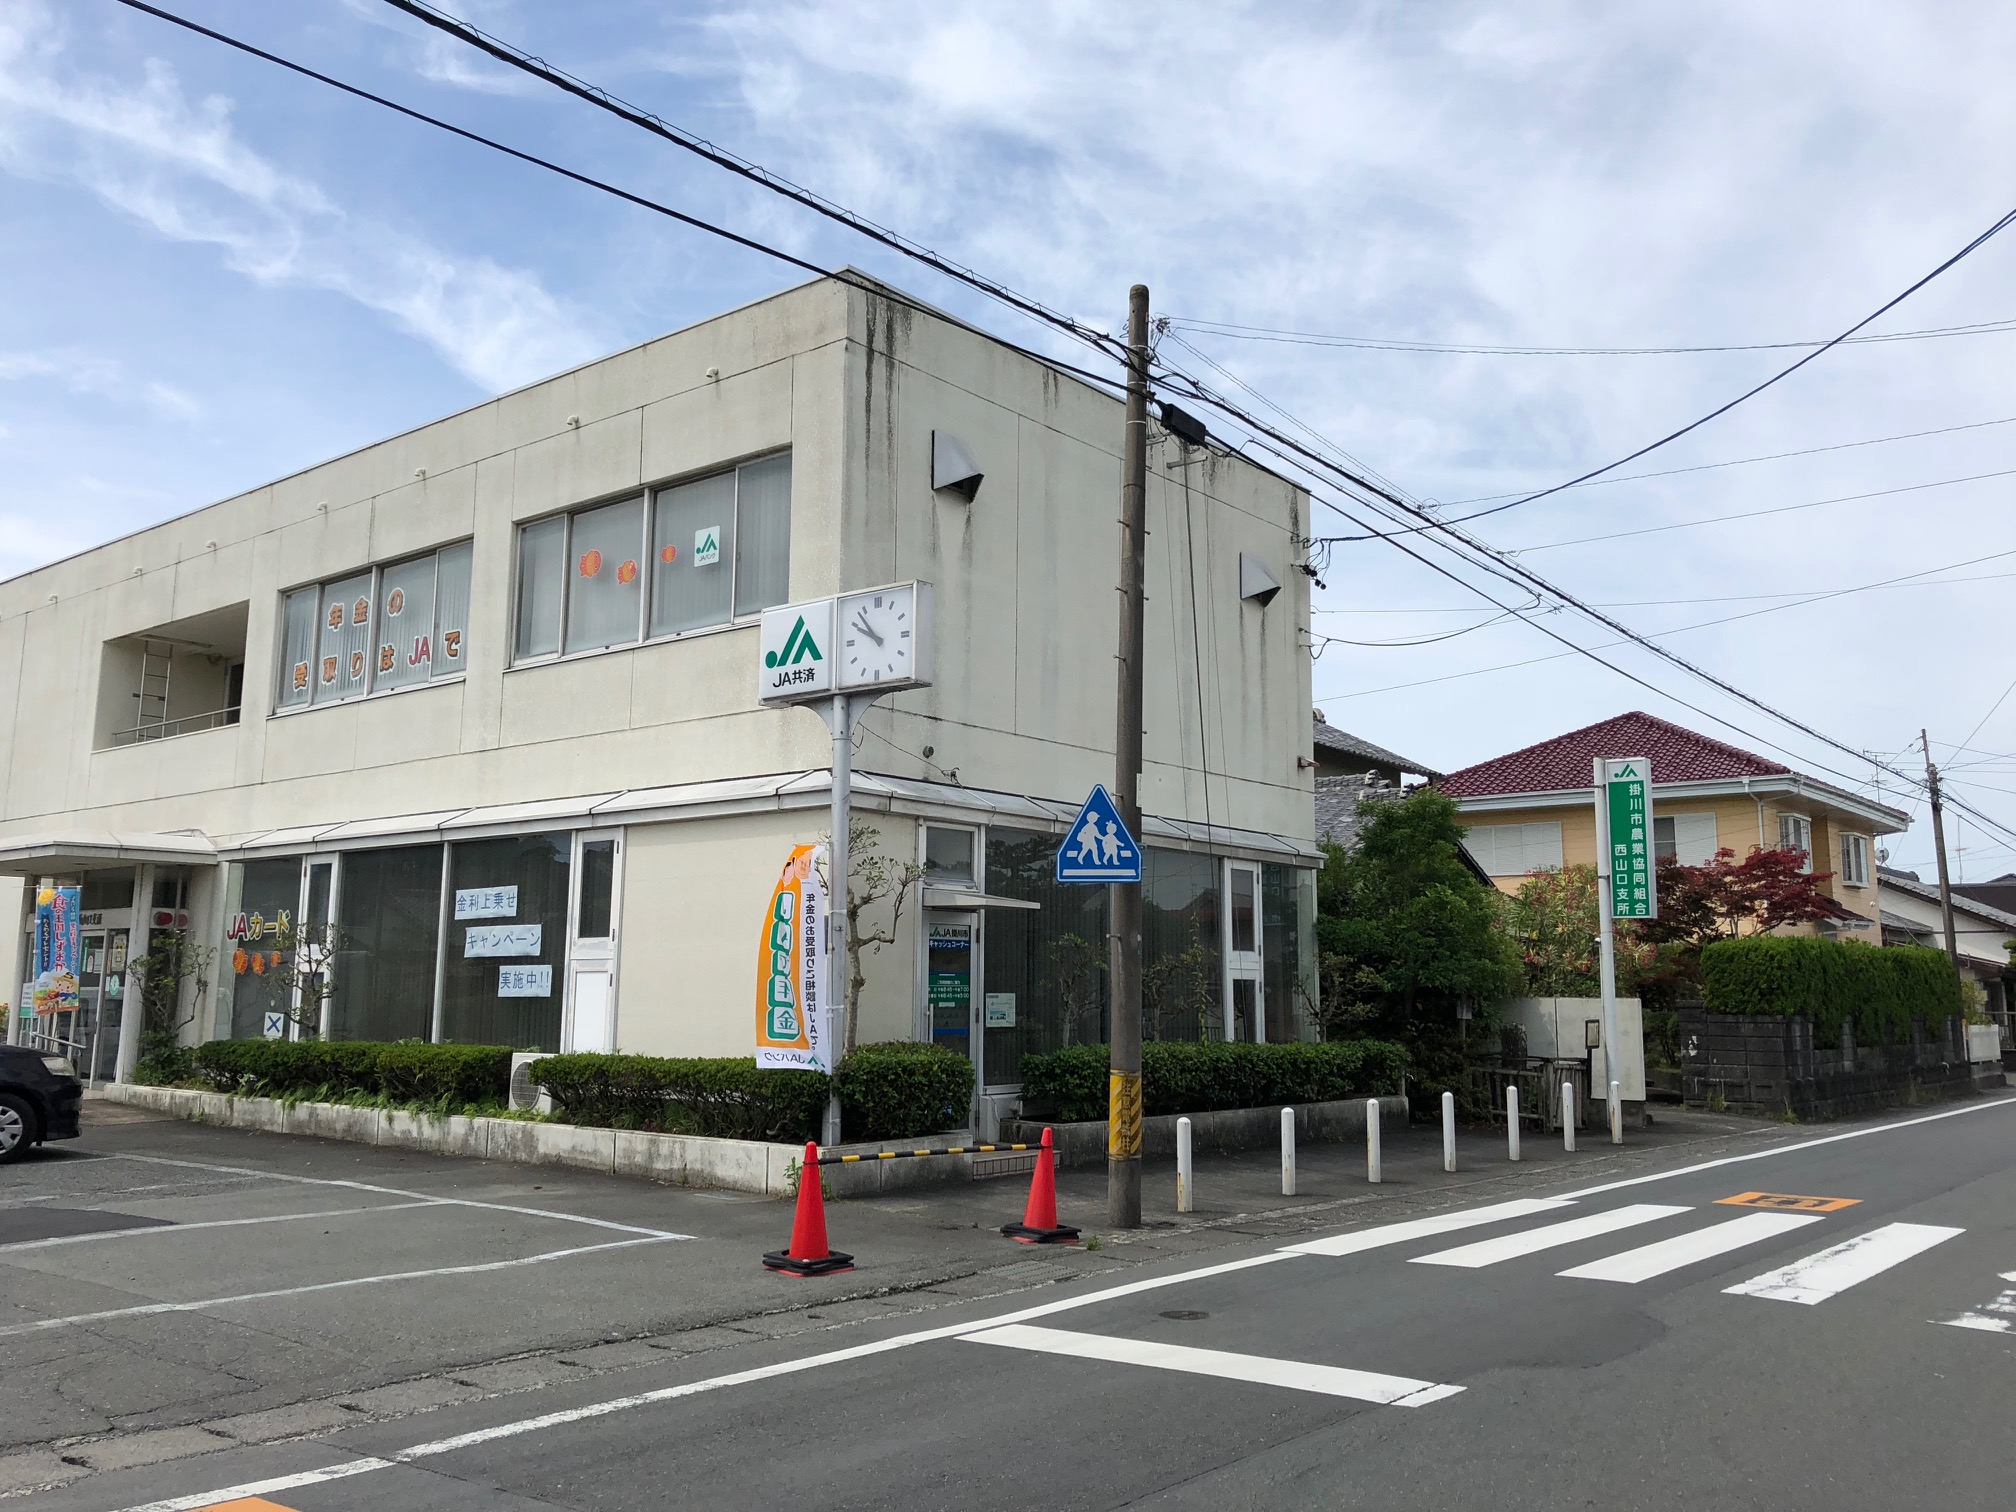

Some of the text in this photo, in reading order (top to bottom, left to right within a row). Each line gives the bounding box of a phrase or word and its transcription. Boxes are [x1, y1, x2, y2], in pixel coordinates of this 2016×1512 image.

[328, 588, 405, 631] 年金の
[293, 630, 461, 691] 受取りはJAで
[772, 667, 816, 688] JA共済
[1629, 784, 1647, 915] 掛川市農業協同組合
[1614, 844, 1629, 915] 西山口支所
[456, 892, 516, 912] 金利上乗せ
[227, 909, 291, 941] JAカード
[466, 931, 540, 949] キャンペーン
[929, 940, 969, 948] キャッシュコーナー
